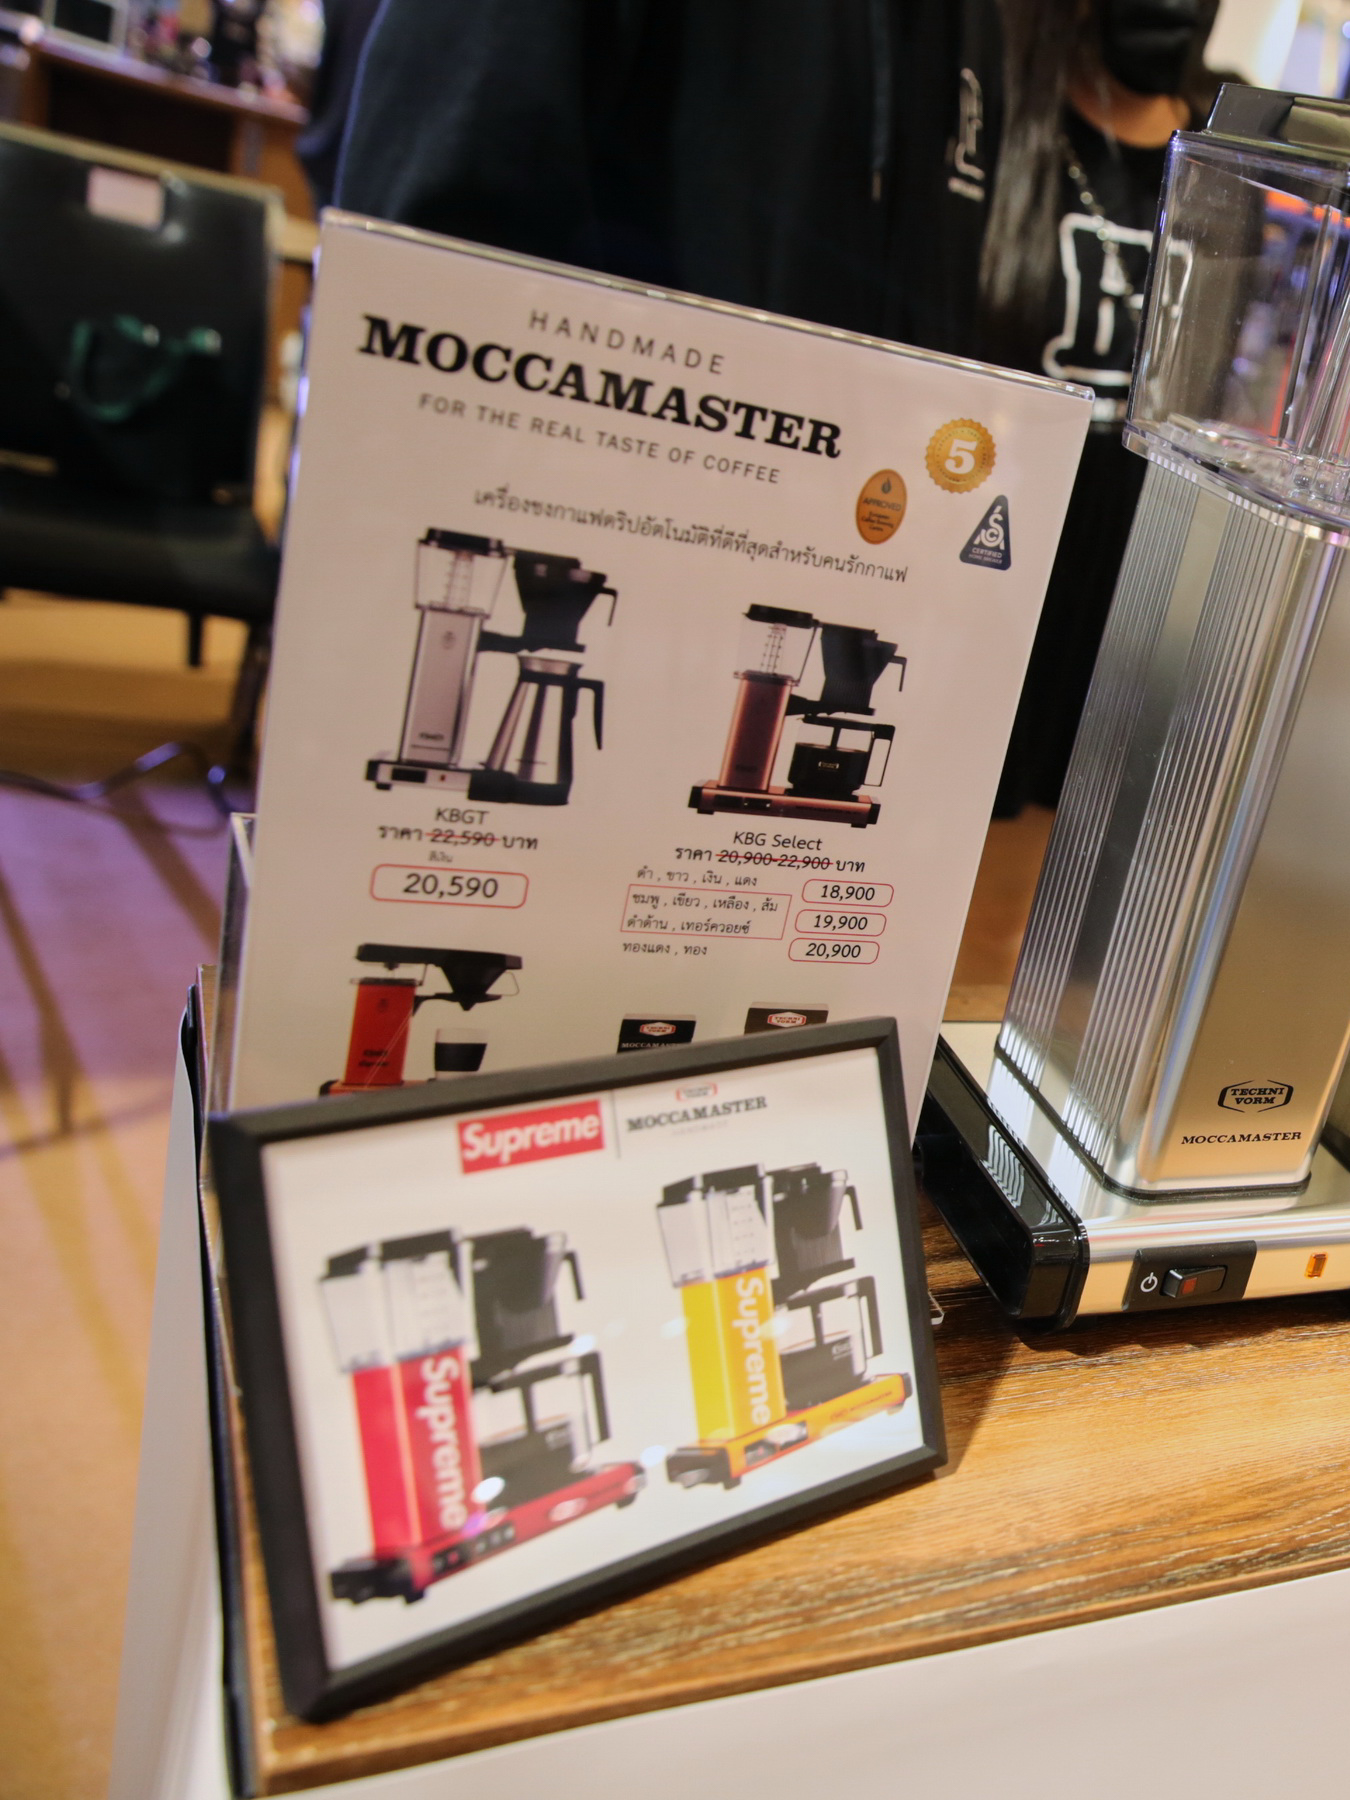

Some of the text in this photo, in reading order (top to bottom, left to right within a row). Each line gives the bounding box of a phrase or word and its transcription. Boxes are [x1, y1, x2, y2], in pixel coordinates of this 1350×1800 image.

[529, 309, 726, 376] HANDMADE
[357, 313, 842, 460] MOCCAMASTER
[418, 392, 782, 485] FOR THE REAL TASTE OF COFFEE
[944, 438, 978, 475] 5
[434, 807, 490, 825] KBGT
[377, 825, 538, 850] ราคา 22,590 บาท
[733, 831, 823, 851] KBG Select
[675, 846, 866, 873] ราคา 20,900-22,900 บาท
[403, 872, 499, 899] 20,590
[820, 883, 876, 901] 18,900
[813, 913, 869, 931] 19,900
[805, 942, 862, 960] 20,900
[1230, 1087, 1285, 1096] TECHNI
[1234, 1096, 1276, 1105] VORM
[626, 1096, 768, 1132] MOCCAMASTER
[461, 1113, 600, 1165] Supreme
[1181, 1131, 1302, 1145] MOCCAMASTER
[732, 1277, 771, 1425] Supreme
[415, 1356, 468, 1531] Supreme
